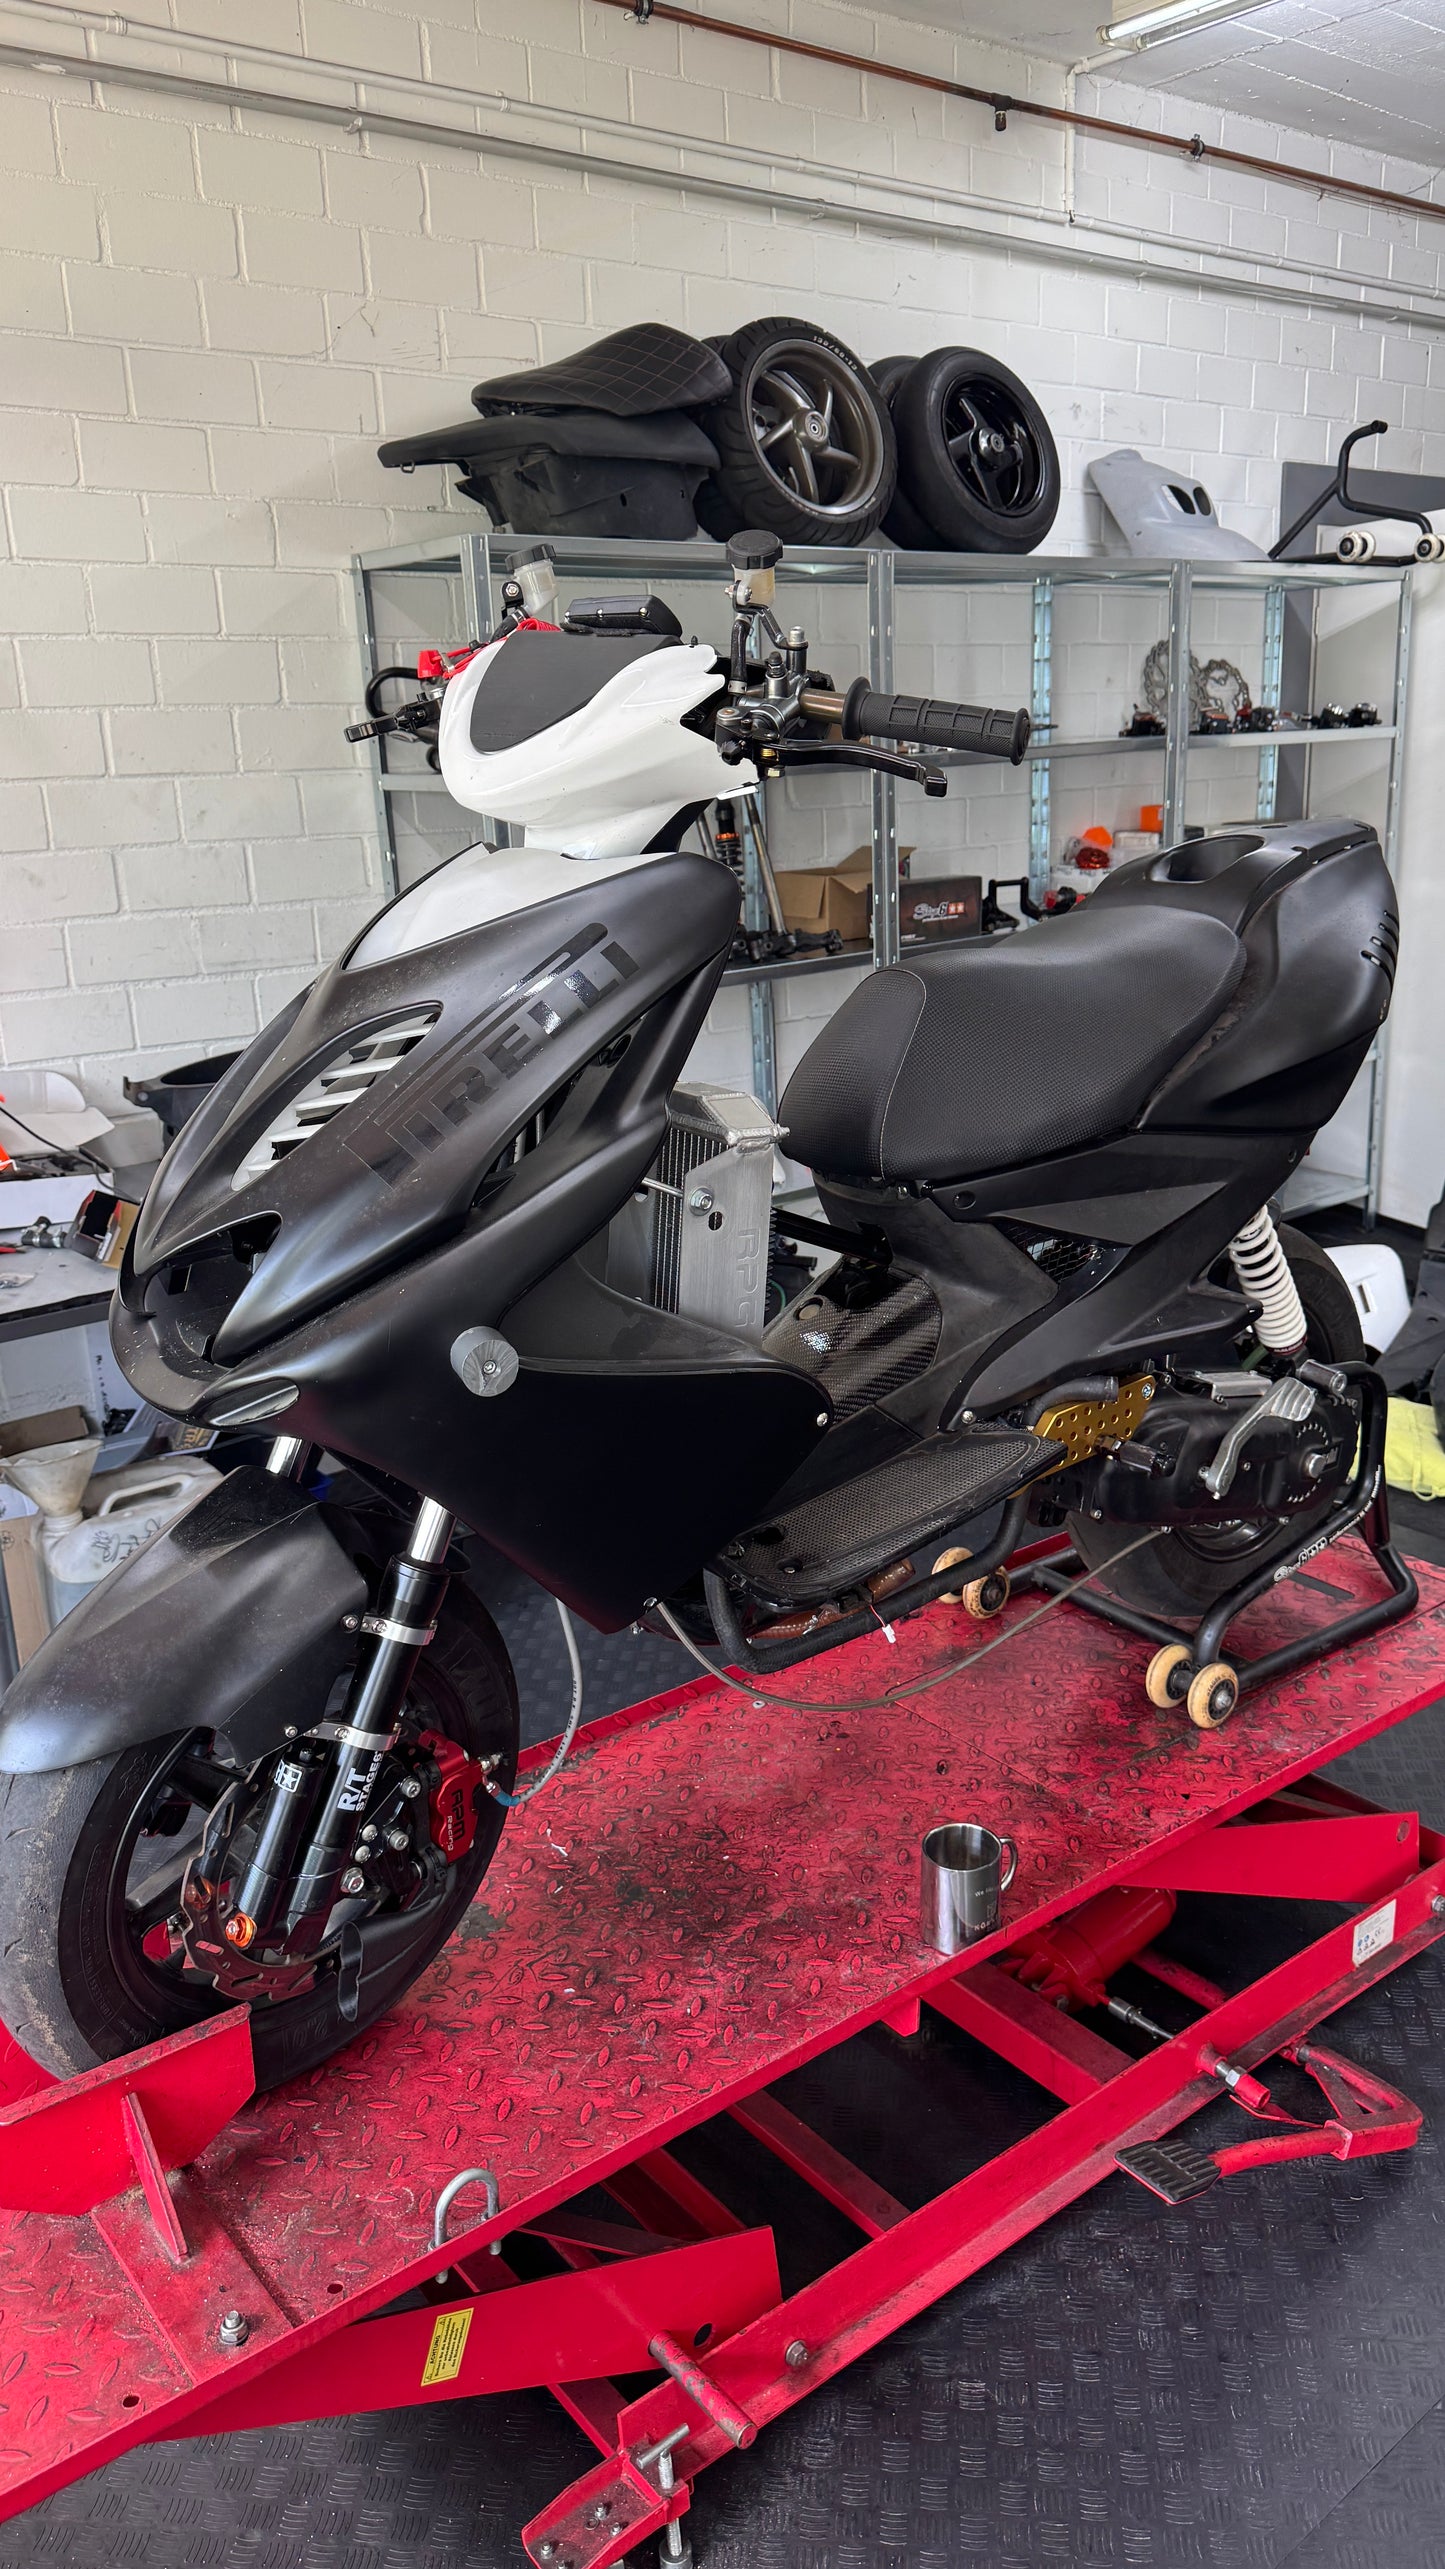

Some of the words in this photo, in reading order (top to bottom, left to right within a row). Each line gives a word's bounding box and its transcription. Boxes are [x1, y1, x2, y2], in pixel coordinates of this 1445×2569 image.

[734, 1227, 761, 1328] RPG
[337, 1767, 367, 1812] R/T
[451, 1788, 466, 1841] APM
